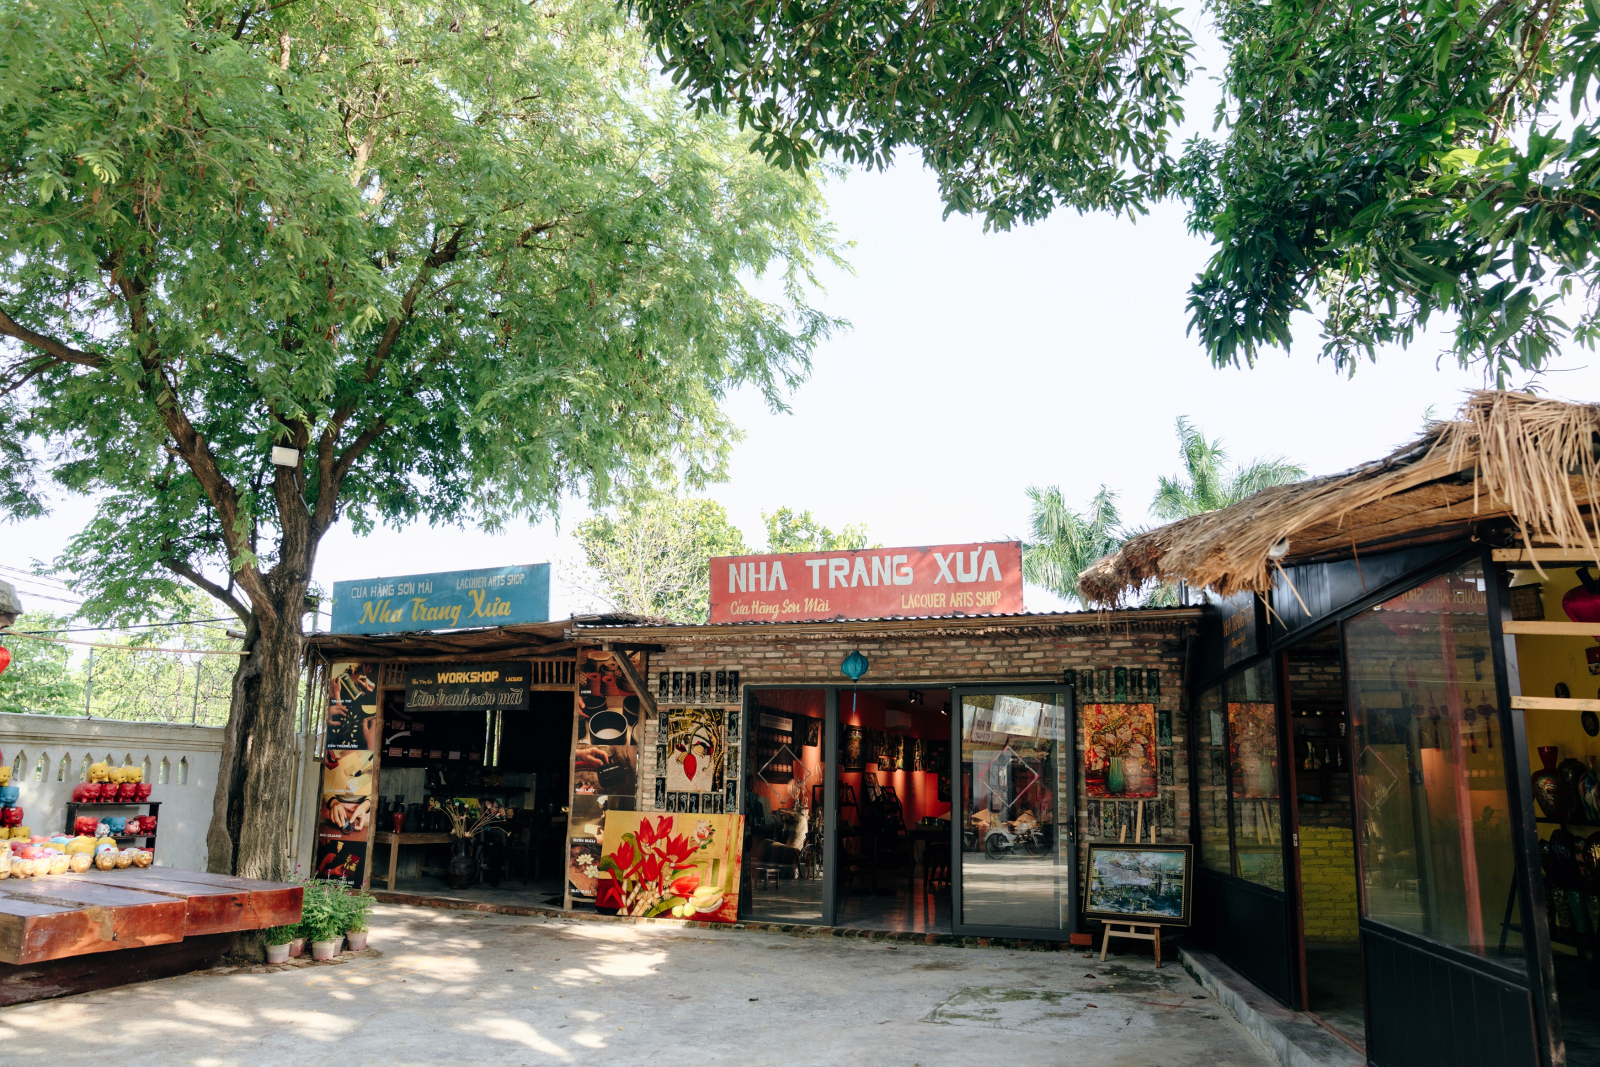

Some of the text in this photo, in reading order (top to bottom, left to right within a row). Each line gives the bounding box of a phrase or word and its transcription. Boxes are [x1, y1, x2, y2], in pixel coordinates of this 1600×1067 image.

[728, 545, 1002, 594] NHA TRANG XƯA
[456, 573, 525, 590] LACQUER ARTS SHOP
[751, 599, 781, 620] Hàng
[804, 597, 831, 614] Mài
[901, 590, 1002, 609] LACQUER ARTS SHOP
[358, 599, 404, 625] Nha
[410, 597, 463, 628] Trang
[437, 671, 499, 684] WORKSHOP
